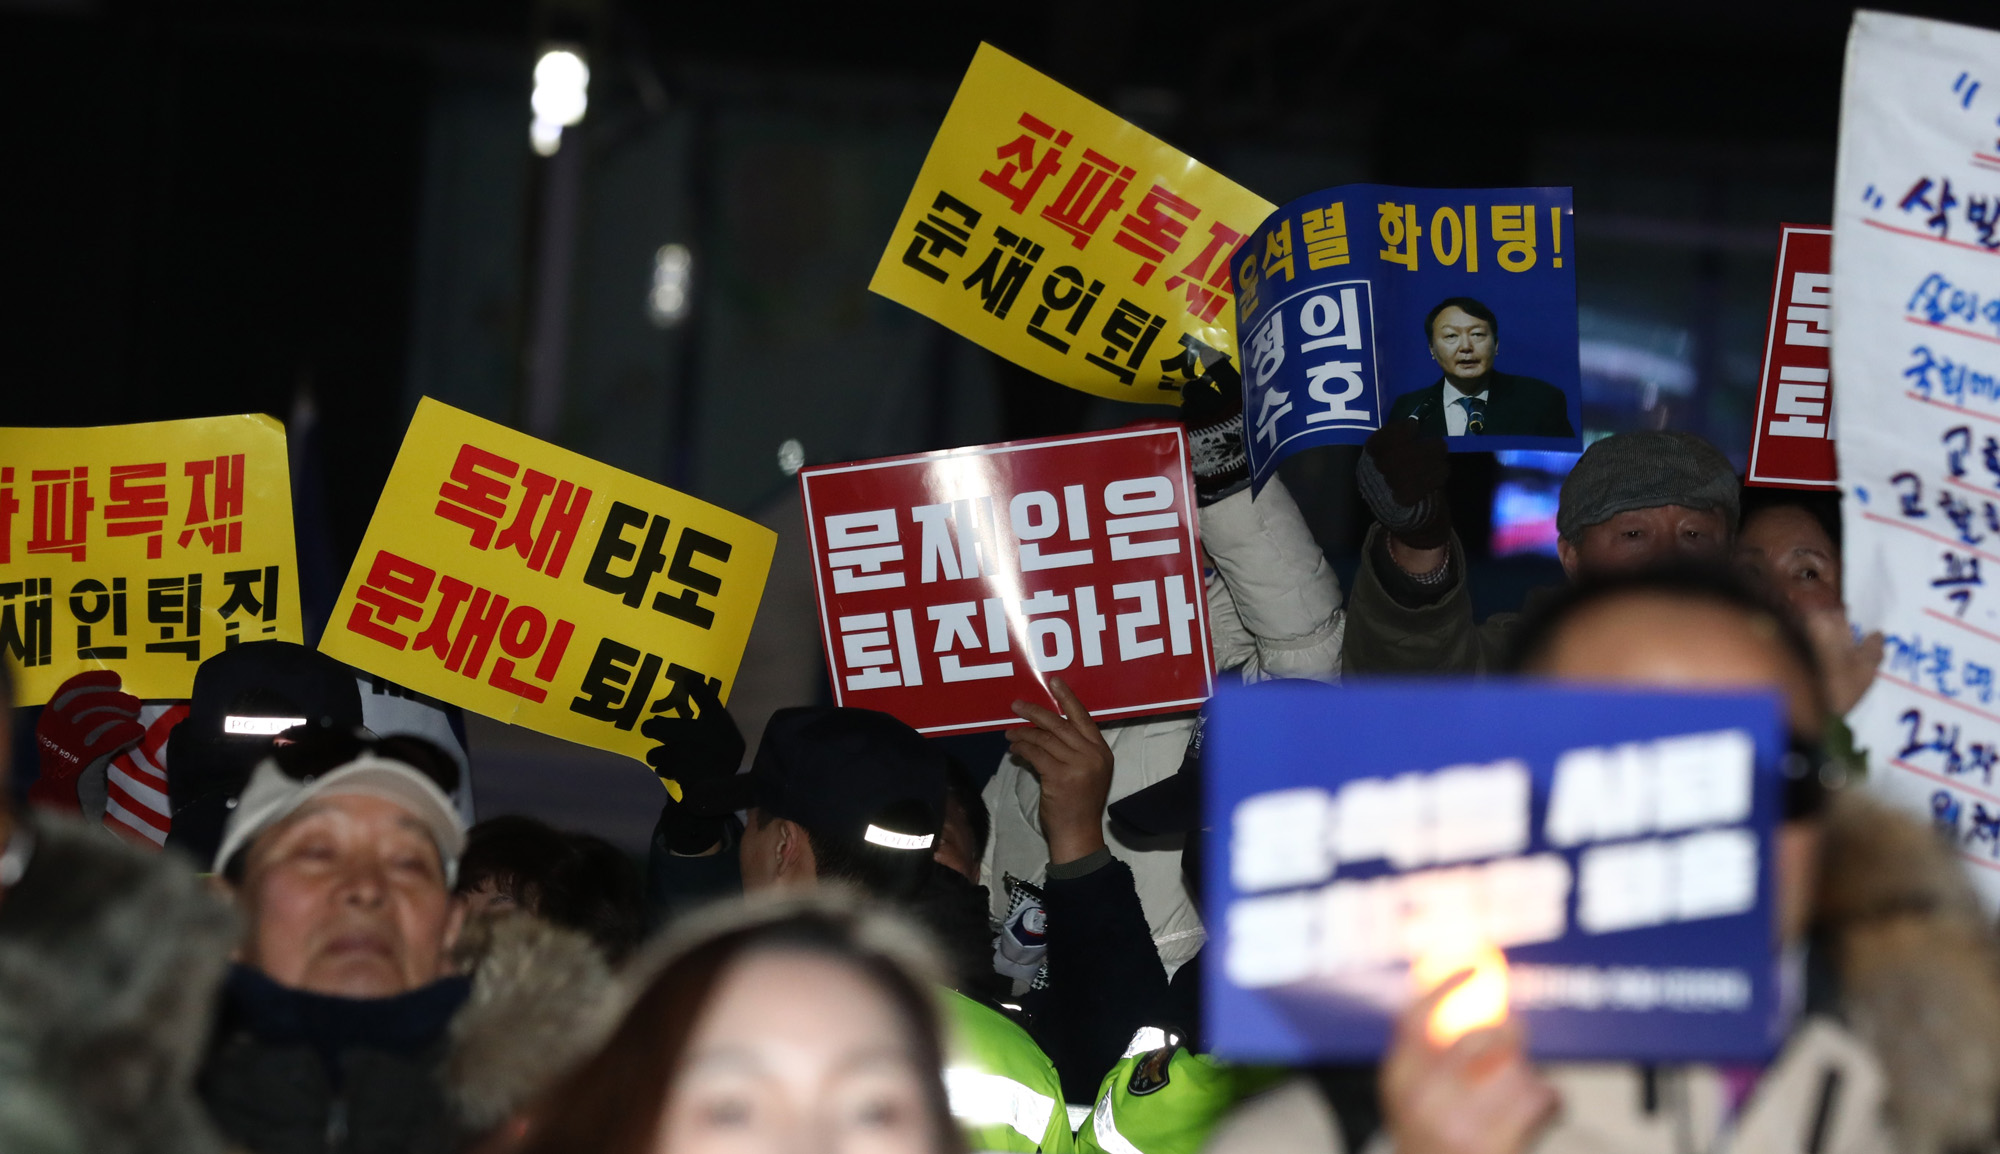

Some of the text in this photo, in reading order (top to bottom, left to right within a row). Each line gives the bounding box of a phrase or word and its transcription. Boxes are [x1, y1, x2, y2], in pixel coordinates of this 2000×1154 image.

[978, 111, 1251, 325] 좌파독재
[1238, 201, 1563, 324] 윤석렬 화이팅!
[1251, 287, 1363, 387] 정의
[1255, 360, 1371, 450] 수호
[434, 443, 733, 631] 독재 타도
[824, 475, 1182, 595] 문재인은
[346, 549, 576, 705] 문재인
[838, 574, 1196, 692] 퇴진하라
[58, 750, 80, 765] HIGH
